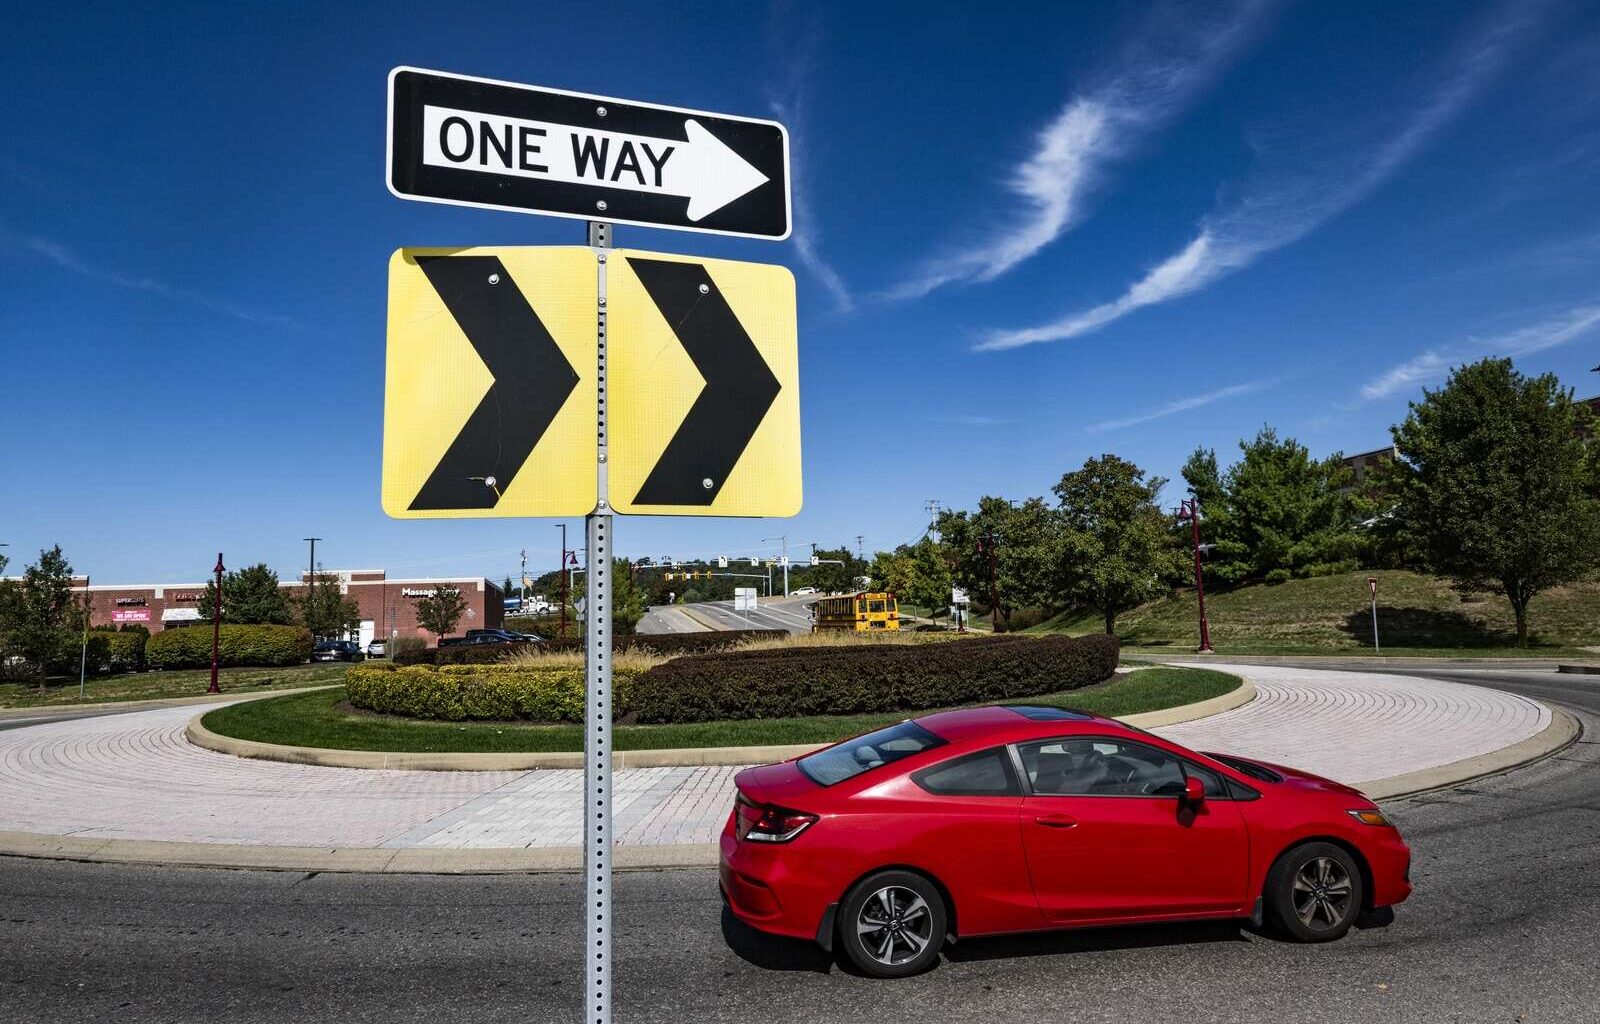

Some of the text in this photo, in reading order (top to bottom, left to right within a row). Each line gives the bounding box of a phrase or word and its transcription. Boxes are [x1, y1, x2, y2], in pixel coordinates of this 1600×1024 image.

[439, 116, 676, 188] ONE WAY
[401, 587, 438, 598] Massage
